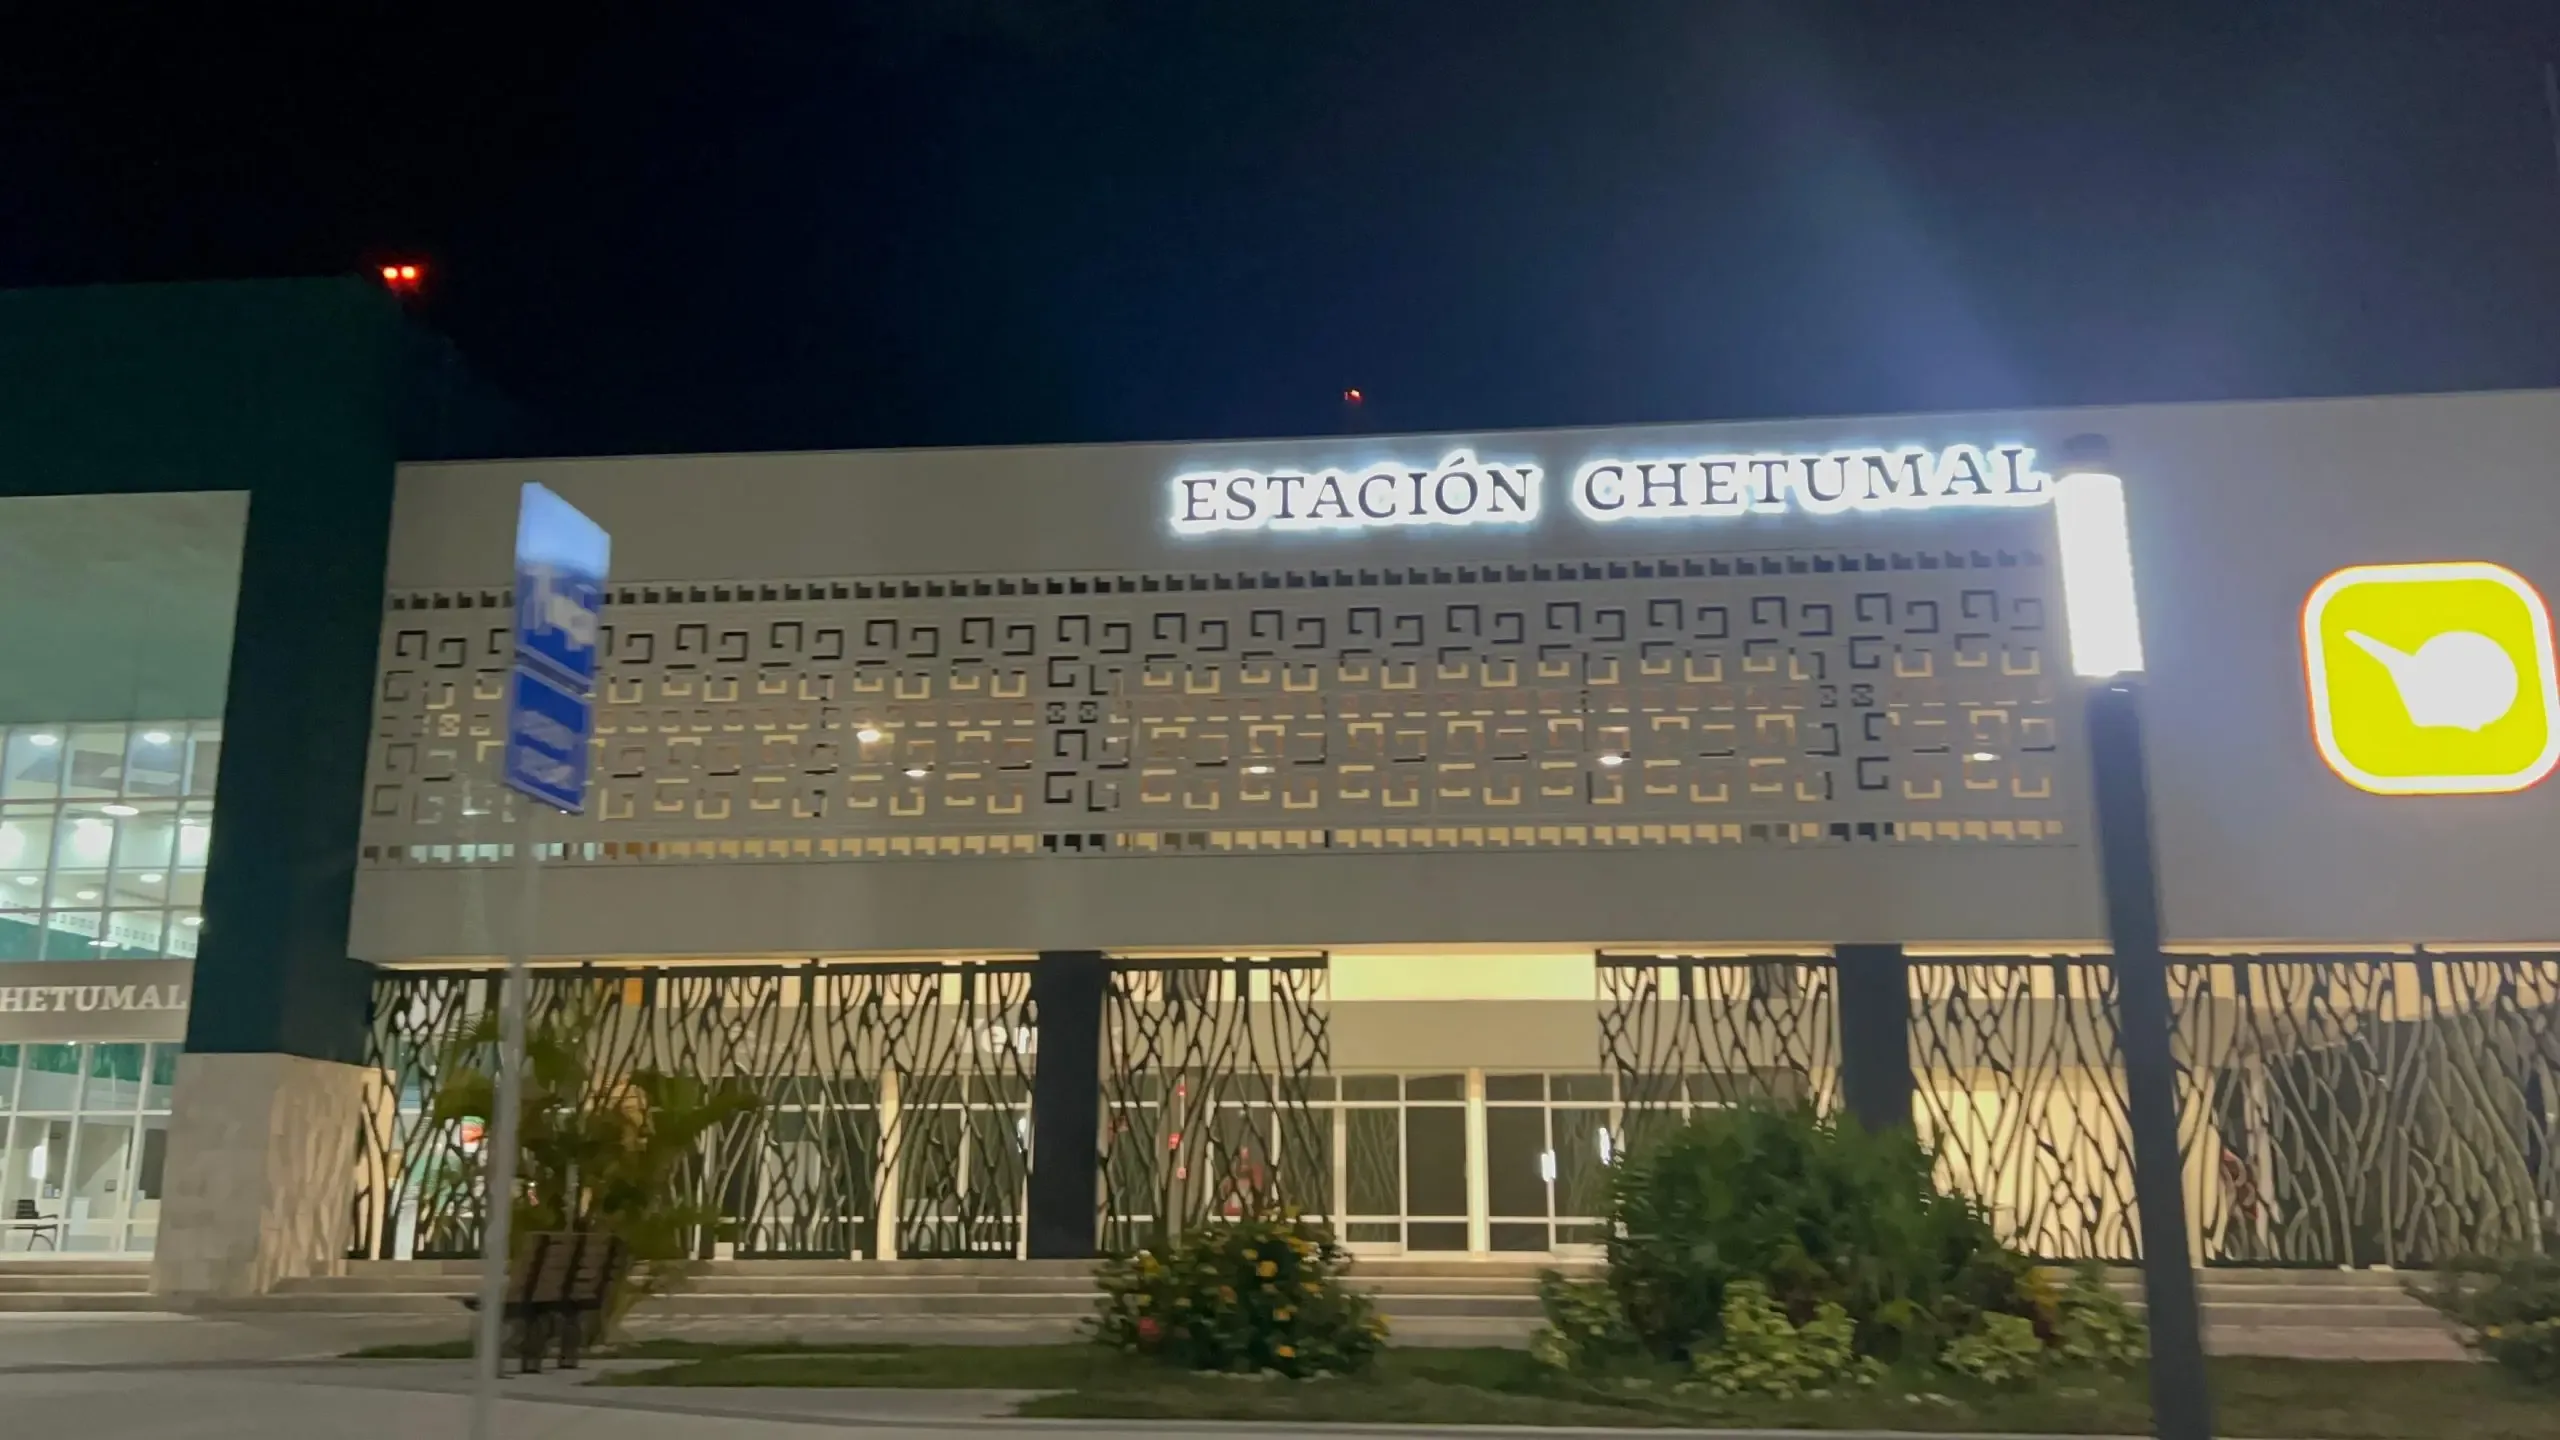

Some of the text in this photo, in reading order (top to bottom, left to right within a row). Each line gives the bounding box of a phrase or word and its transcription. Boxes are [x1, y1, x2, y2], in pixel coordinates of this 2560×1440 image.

[1181, 449, 2043, 521] ESTACIÓN CHETUMAL
[0, 985, 188, 1012] HETUMAL
